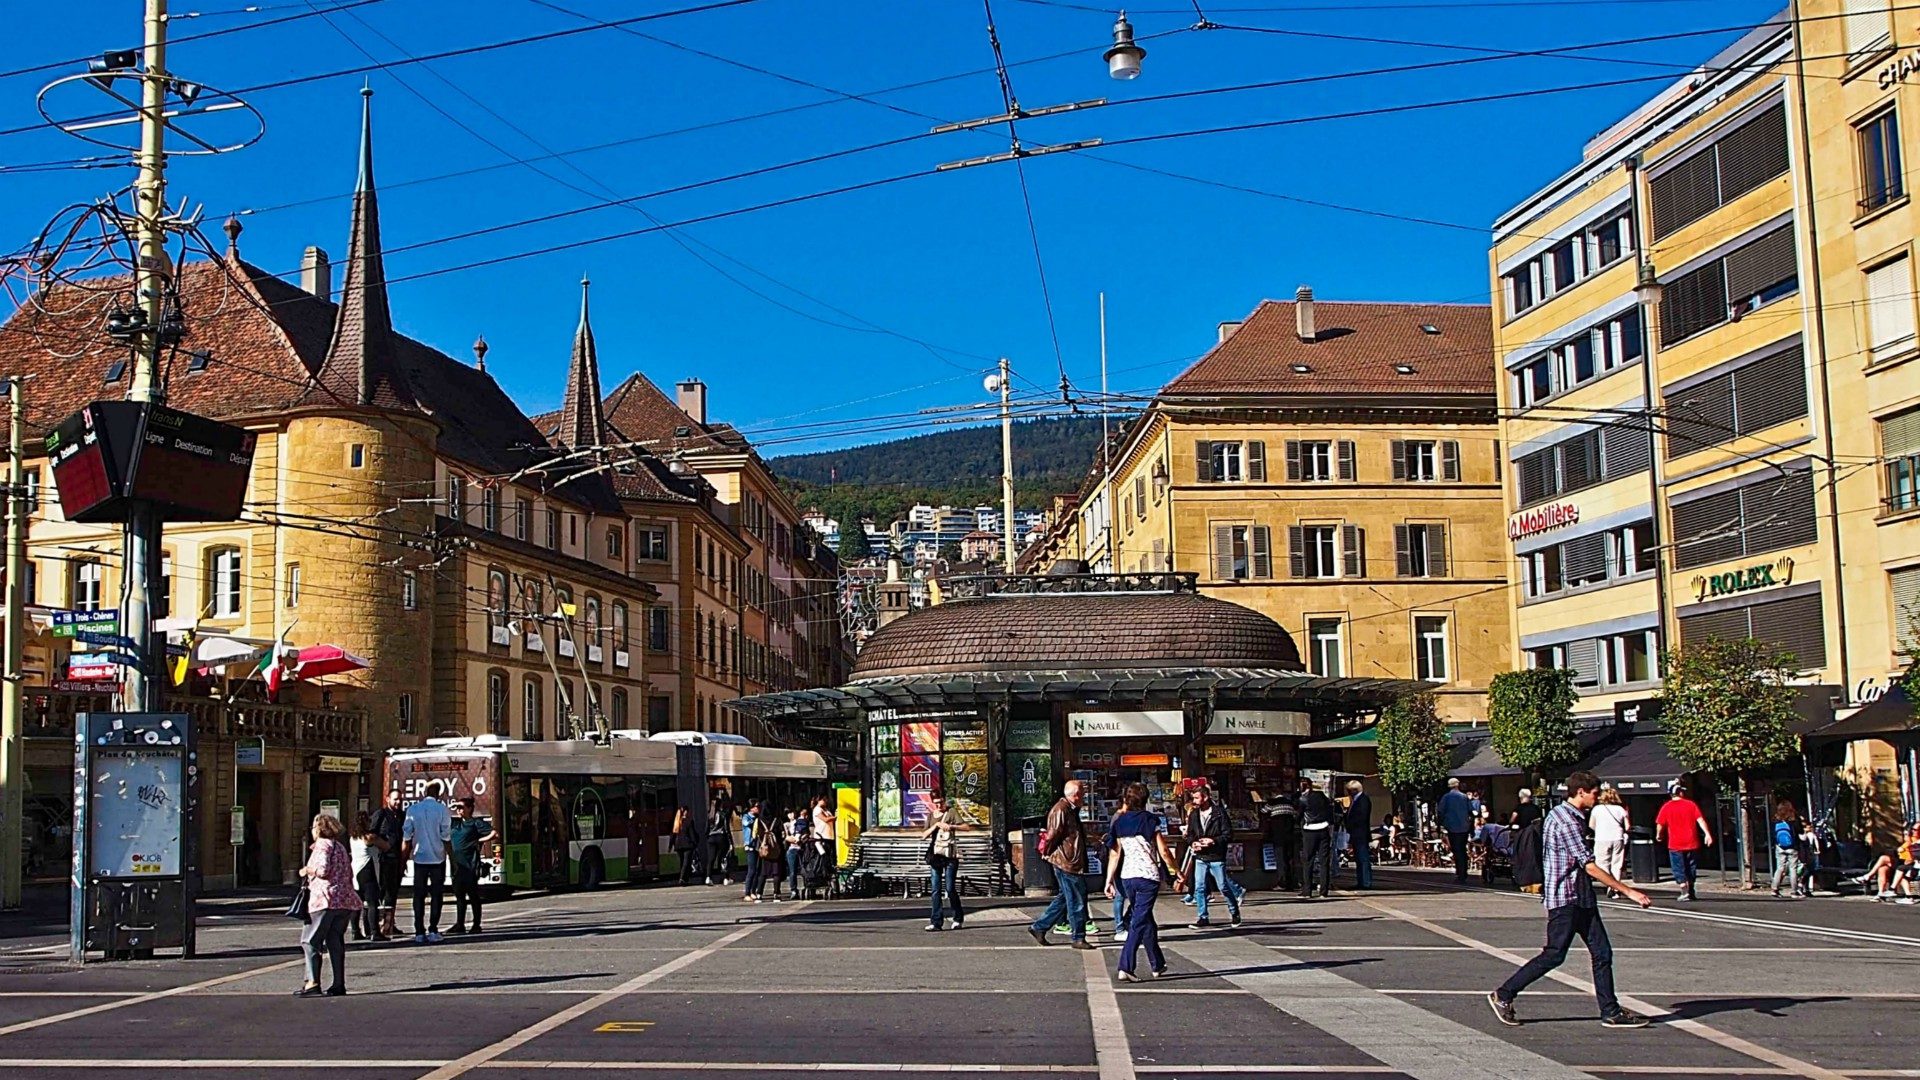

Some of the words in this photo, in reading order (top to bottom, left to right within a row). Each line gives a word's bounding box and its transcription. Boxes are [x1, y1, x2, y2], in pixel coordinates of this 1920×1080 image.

[145, 431, 165, 445] Ligne
[174, 438, 213, 456] Destination
[229, 452, 250, 466] Départ
[1520, 503, 1575, 534] Mobilière
[1709, 563, 1775, 596] ROLEX
[75, 613, 89, 622] Trois
[78, 624, 114, 633] Piscines
[94, 634, 118, 645] Boudry
[71, 682, 91, 692] Villiers
[1087, 722, 1120, 731] NAVILLE
[1238, 721, 1266, 729] NAVILLE
[393, 778, 458, 799] LEROY
